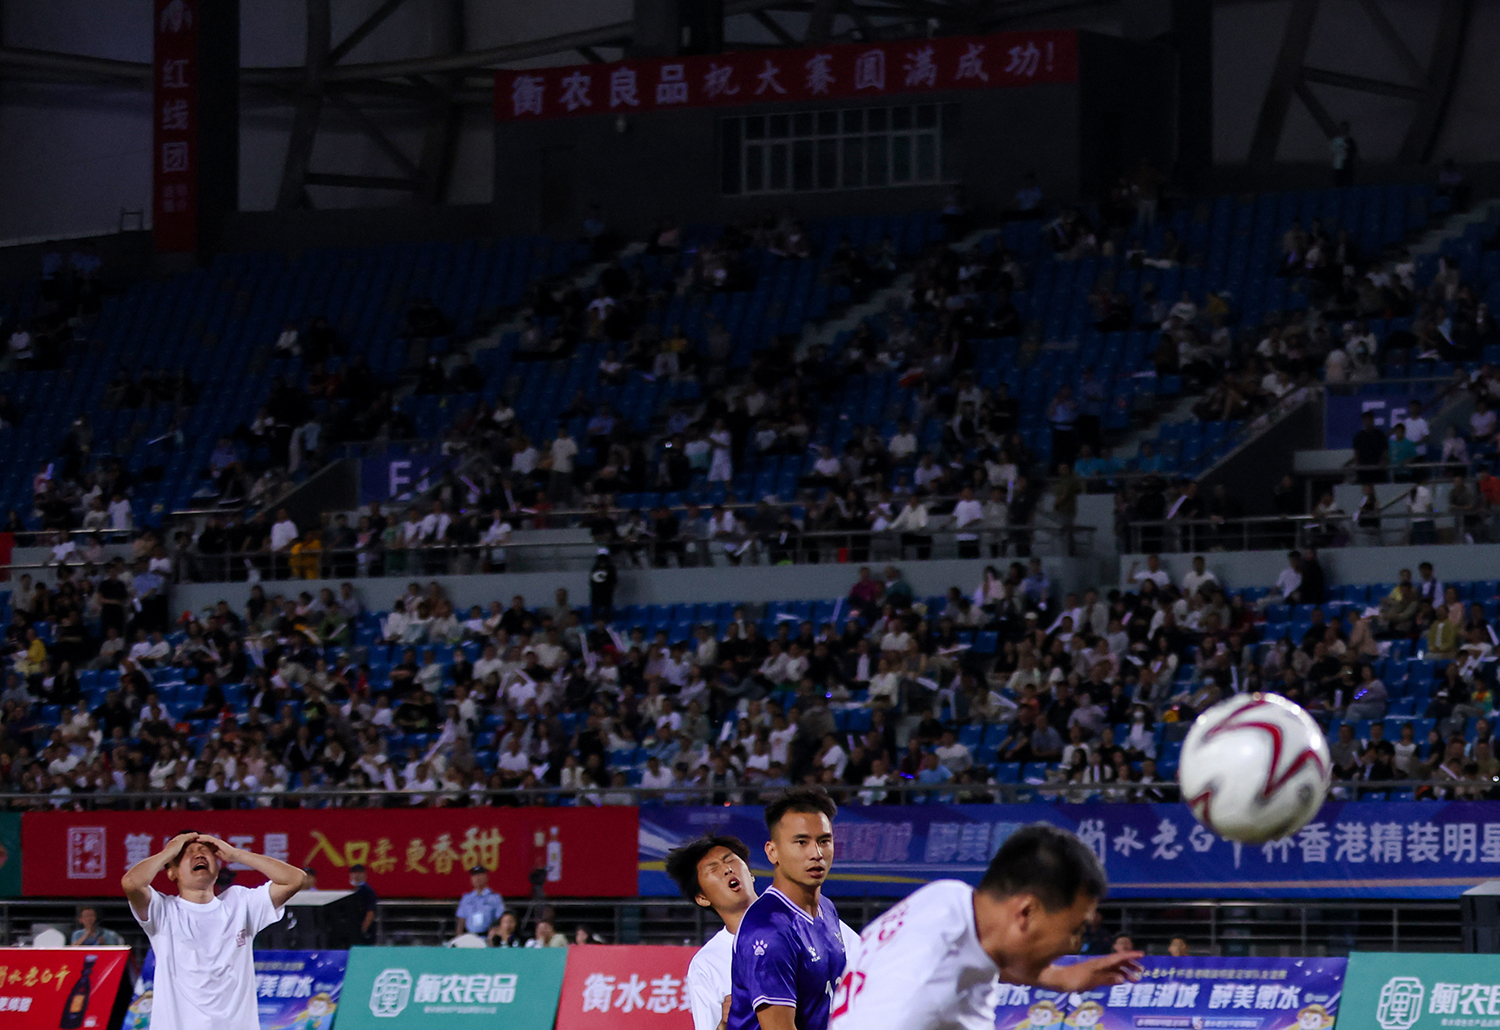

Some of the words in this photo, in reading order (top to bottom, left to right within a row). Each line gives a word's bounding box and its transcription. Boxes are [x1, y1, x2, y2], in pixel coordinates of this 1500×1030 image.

[162, 59, 190, 173] 红线团
[413, 974, 518, 1004] 衡农良品
